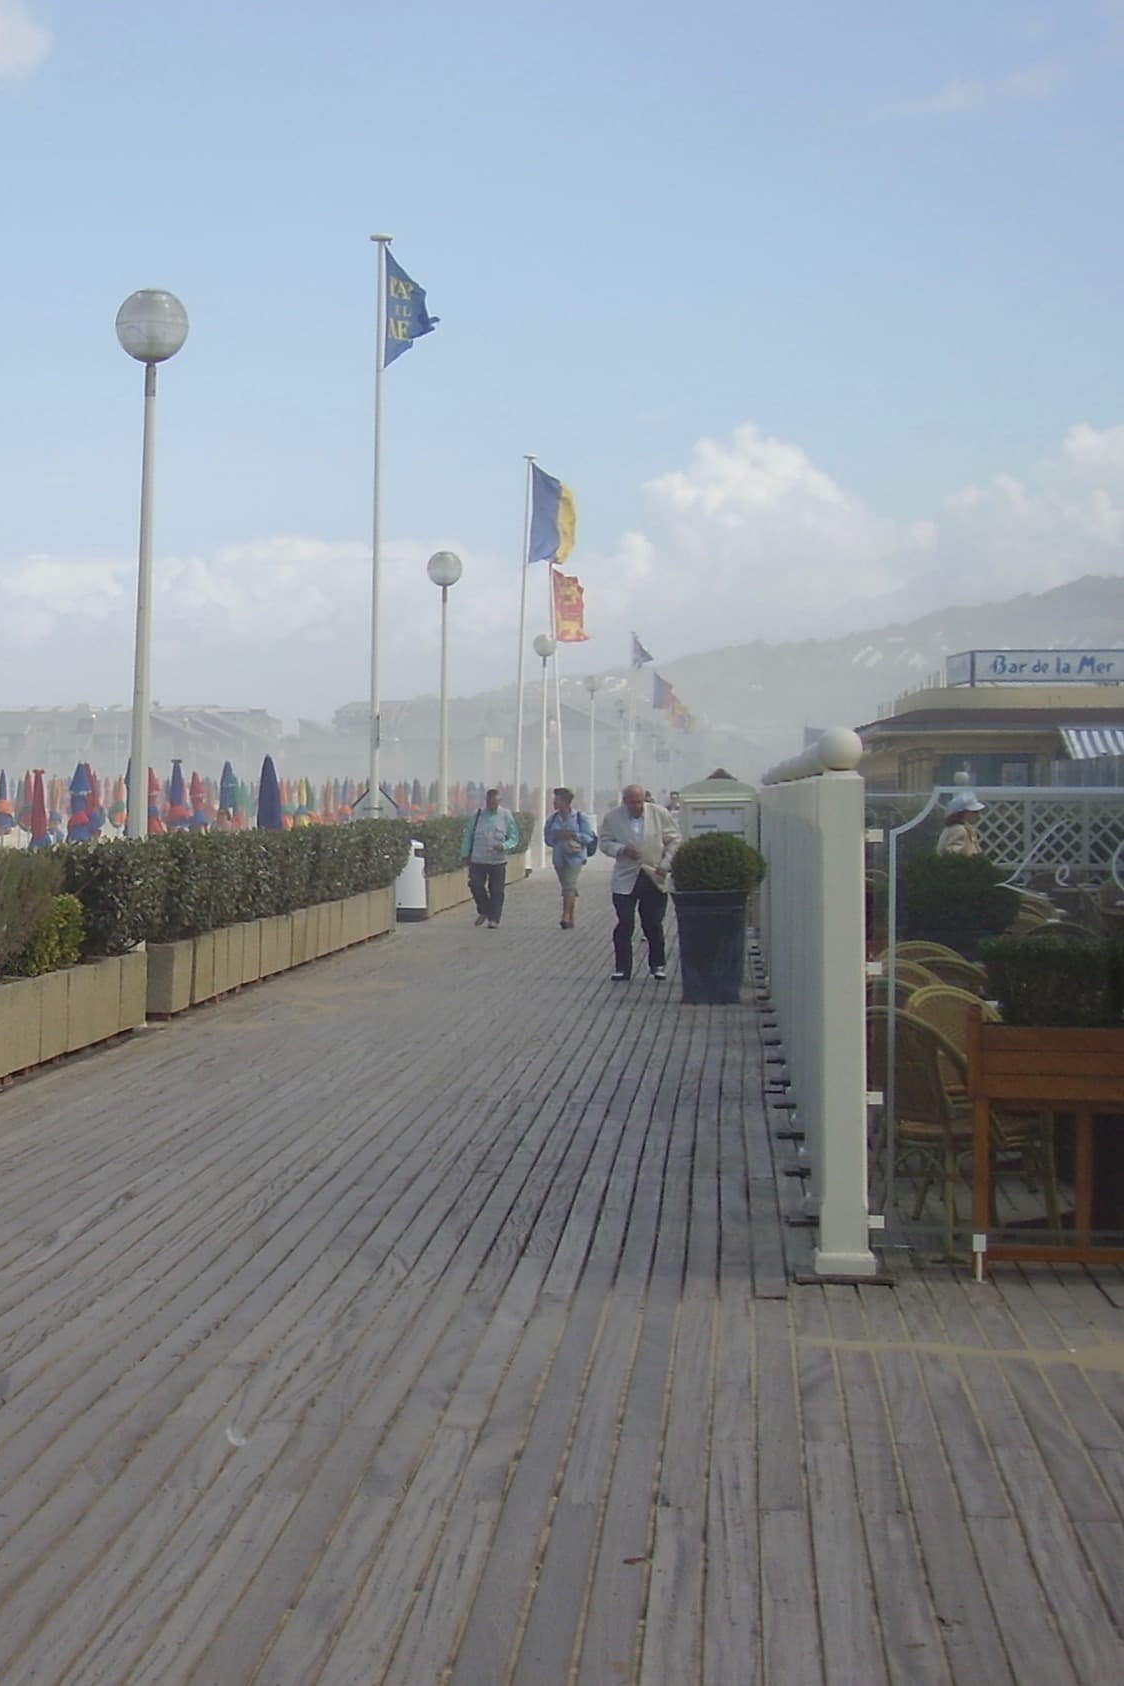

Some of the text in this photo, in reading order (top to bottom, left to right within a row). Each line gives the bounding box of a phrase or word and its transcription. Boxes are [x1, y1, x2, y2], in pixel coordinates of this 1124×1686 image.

[991, 655, 1116, 675] Bar de la Mer
